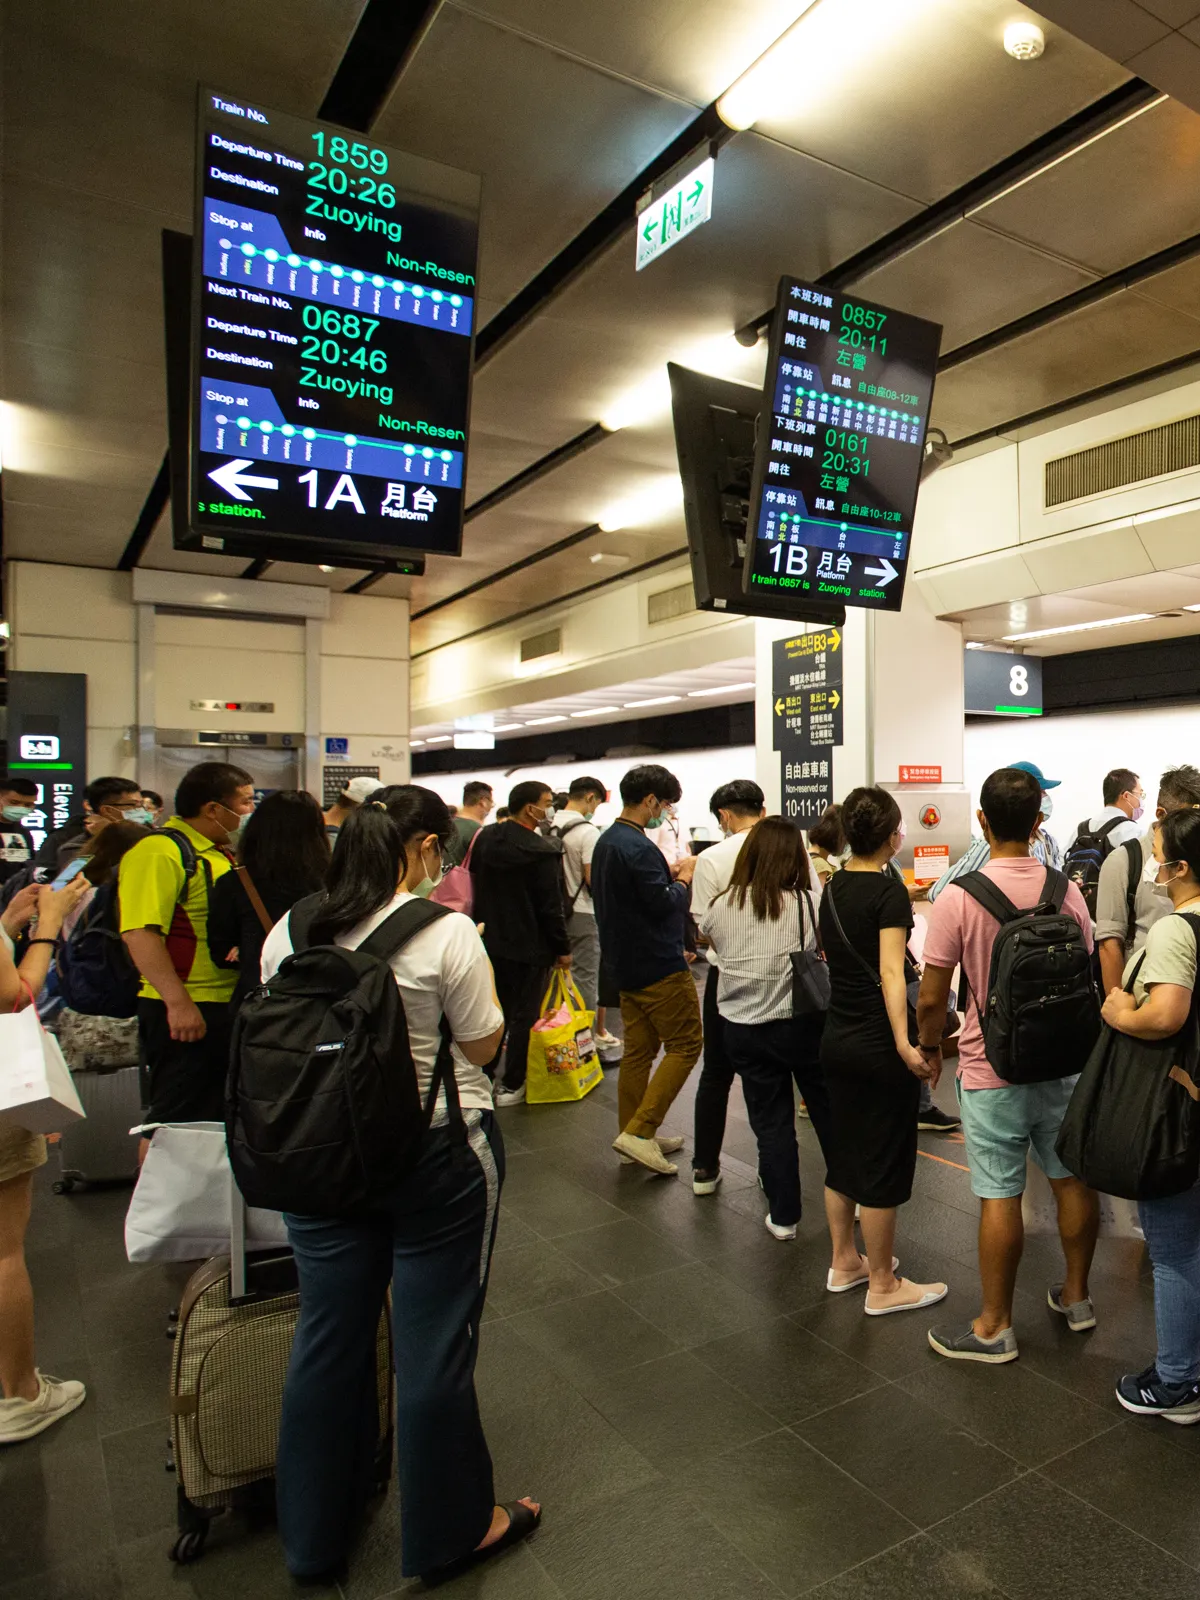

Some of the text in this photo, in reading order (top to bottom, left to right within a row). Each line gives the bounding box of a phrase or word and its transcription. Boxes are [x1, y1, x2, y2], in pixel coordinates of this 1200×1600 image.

[212, 96, 269, 124] Train No.
[211, 134, 305, 172] Departure Time
[311, 131, 389, 175] 1859
[210, 166, 279, 195] Destination
[307, 161, 396, 209] 20:26
[209, 211, 254, 233] Stop at
[305, 194, 402, 243] Zuoying
[304, 226, 327, 242] Info
[208, 281, 293, 311] Next Train No.
[790, 285, 834, 308] 本班列車
[302, 305, 380, 342] 0687
[787, 308, 831, 333] 開車時間
[841, 303, 888, 332] 0857
[206, 317, 298, 345] Departure Time
[784, 332, 807, 349] 開往
[838, 325, 888, 356] 20:11
[206, 348, 274, 370] Destination
[301, 335, 388, 374] 20:46
[836, 349, 867, 372] 左營
[781, 363, 814, 381] 停靠站
[831, 373, 852, 389] 訊息
[299, 366, 394, 405] Zuoying
[206, 390, 249, 407] Stop at
[298, 397, 320, 410] Info
[793, 396, 803, 417] 台北
[775, 415, 817, 435] 下班列車
[831, 405, 840, 426] 新竹
[854, 412, 863, 431] 台中
[771, 438, 814, 458] 開車時間
[825, 429, 868, 455] 0161
[768, 461, 791, 476] 開往
[821, 451, 870, 476] 20:31
[298, 469, 366, 515] 1A
[819, 473, 850, 494] 左營
[381, 482, 438, 513] 月台
[765, 490, 797, 507] 停靠站
[815, 497, 835, 511] 訊息
[209, 501, 266, 520] station.
[381, 507, 428, 522] Platform
[841, 502, 902, 523] 自由座10-12車
[765, 520, 775, 540] 南港
[777, 522, 787, 542] 台北
[790, 524, 800, 544] 板橋
[837, 531, 847, 550] 台中
[769, 542, 809, 576] 1B
[893, 541, 902, 559] 左營
[817, 551, 852, 573] 月台
[816, 569, 845, 581] Platform
[757, 574, 777, 586] train
[779, 577, 801, 588] 0857
[802, 580, 810, 590] is
[818, 582, 851, 596] Zuoying
[859, 588, 887, 599] station.
[801, 635, 814, 649] 出口
[814, 633, 826, 652] B3
[1009, 664, 1029, 697] 8
[786, 696, 801, 707] 西出口
[810, 692, 826, 703] 東出口
[785, 759, 829, 780] 自由座車廂
[785, 784, 828, 793] Non-reserved car
[1140, 1388, 1157, 1404] N
